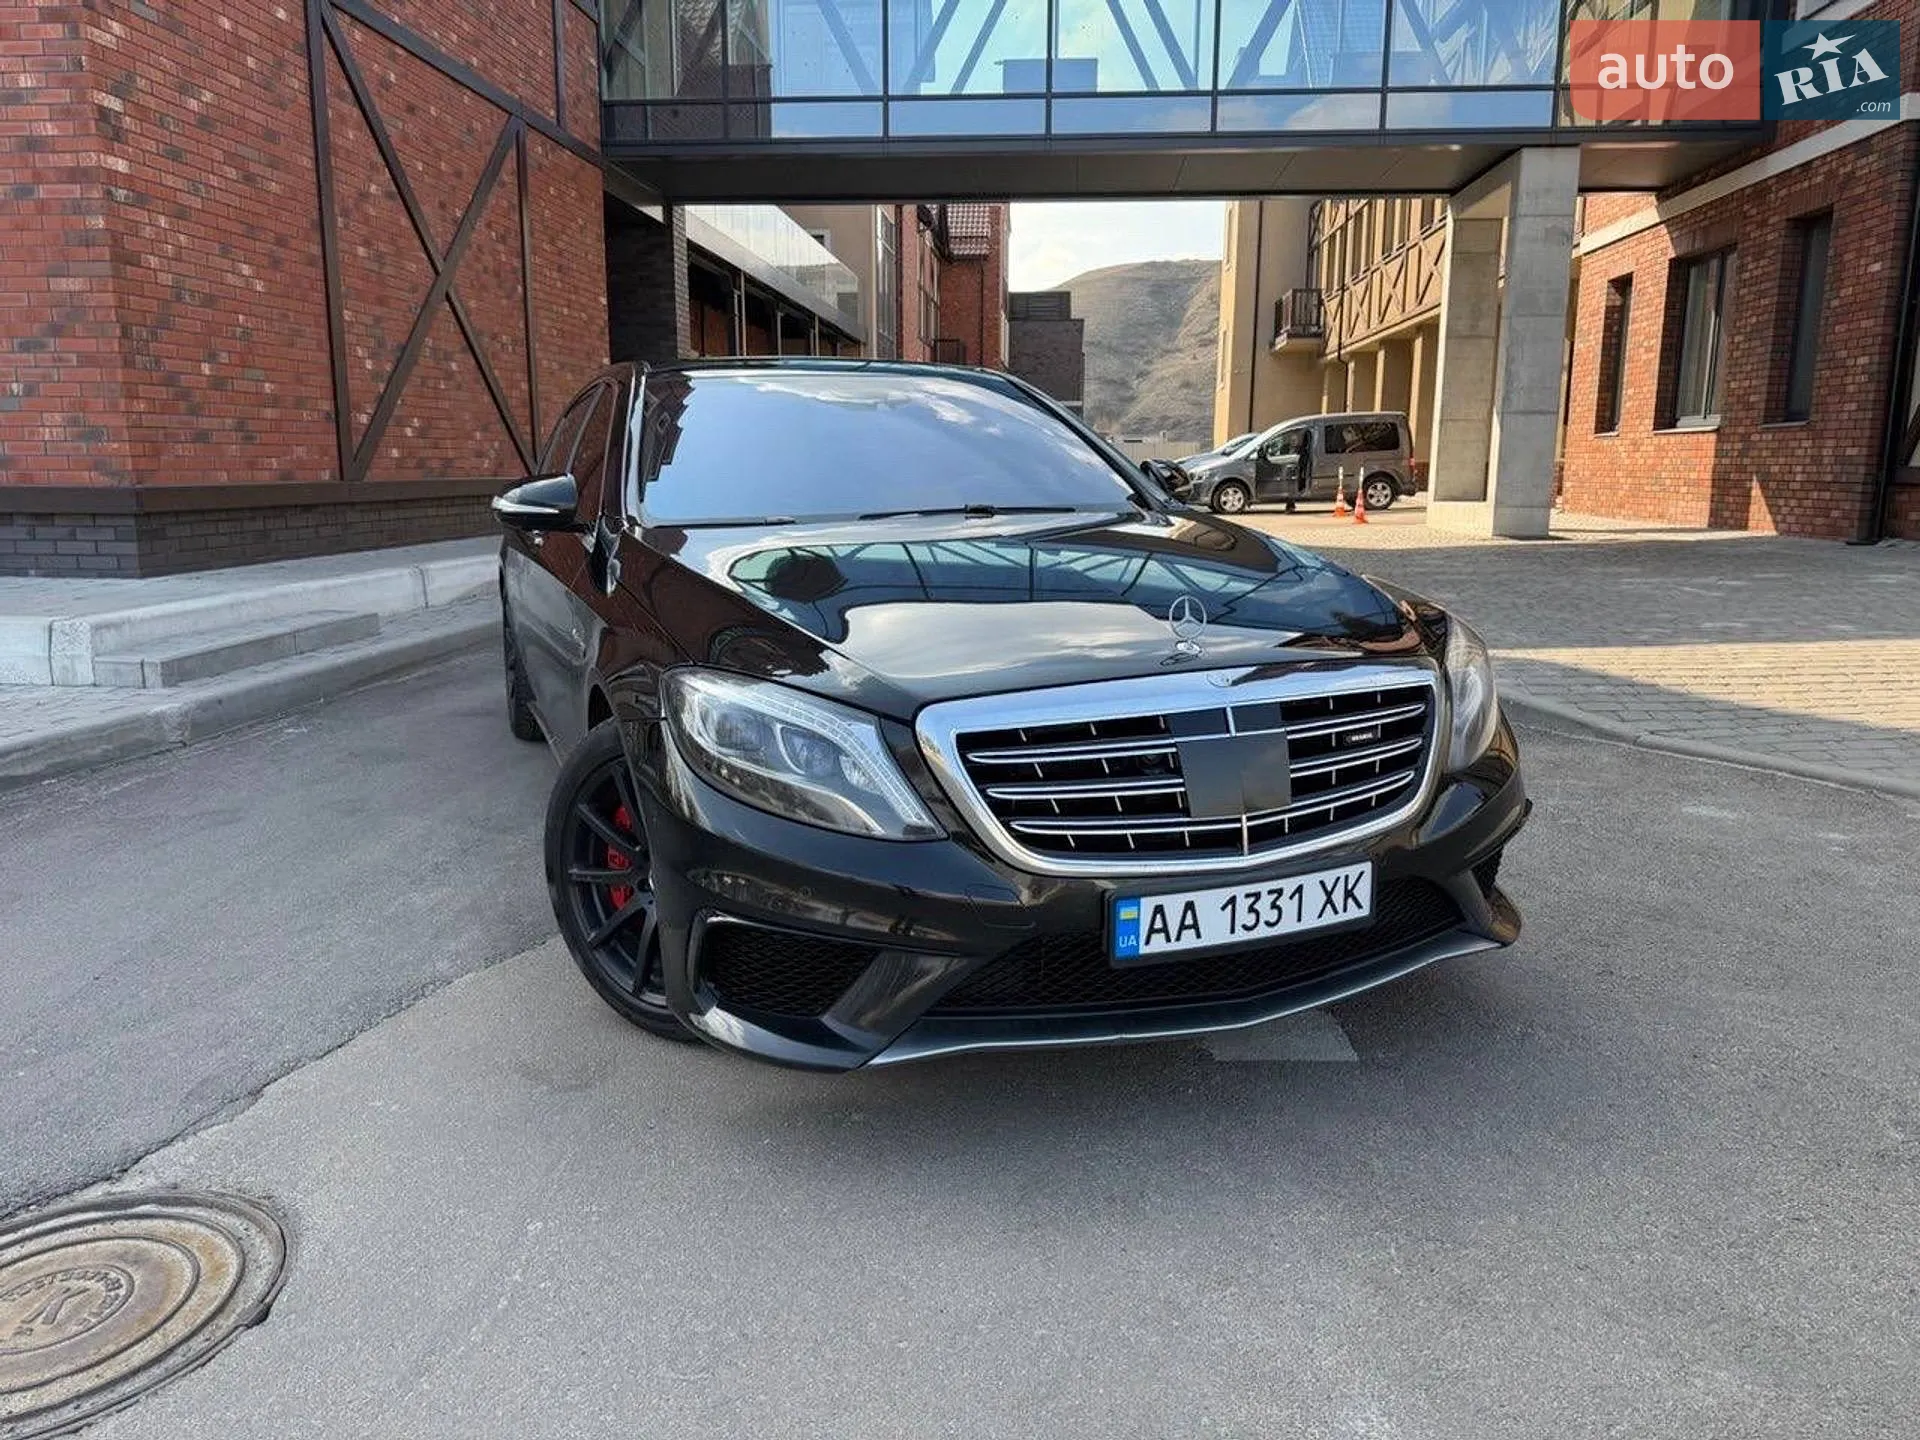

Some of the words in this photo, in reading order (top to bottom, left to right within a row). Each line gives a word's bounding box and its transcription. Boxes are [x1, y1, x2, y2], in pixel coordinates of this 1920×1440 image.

[1144, 900, 1202, 946] AA
[1220, 884, 1304, 935] 1331
[1317, 870, 1366, 919] XK
[1119, 935, 1138, 948] UA
